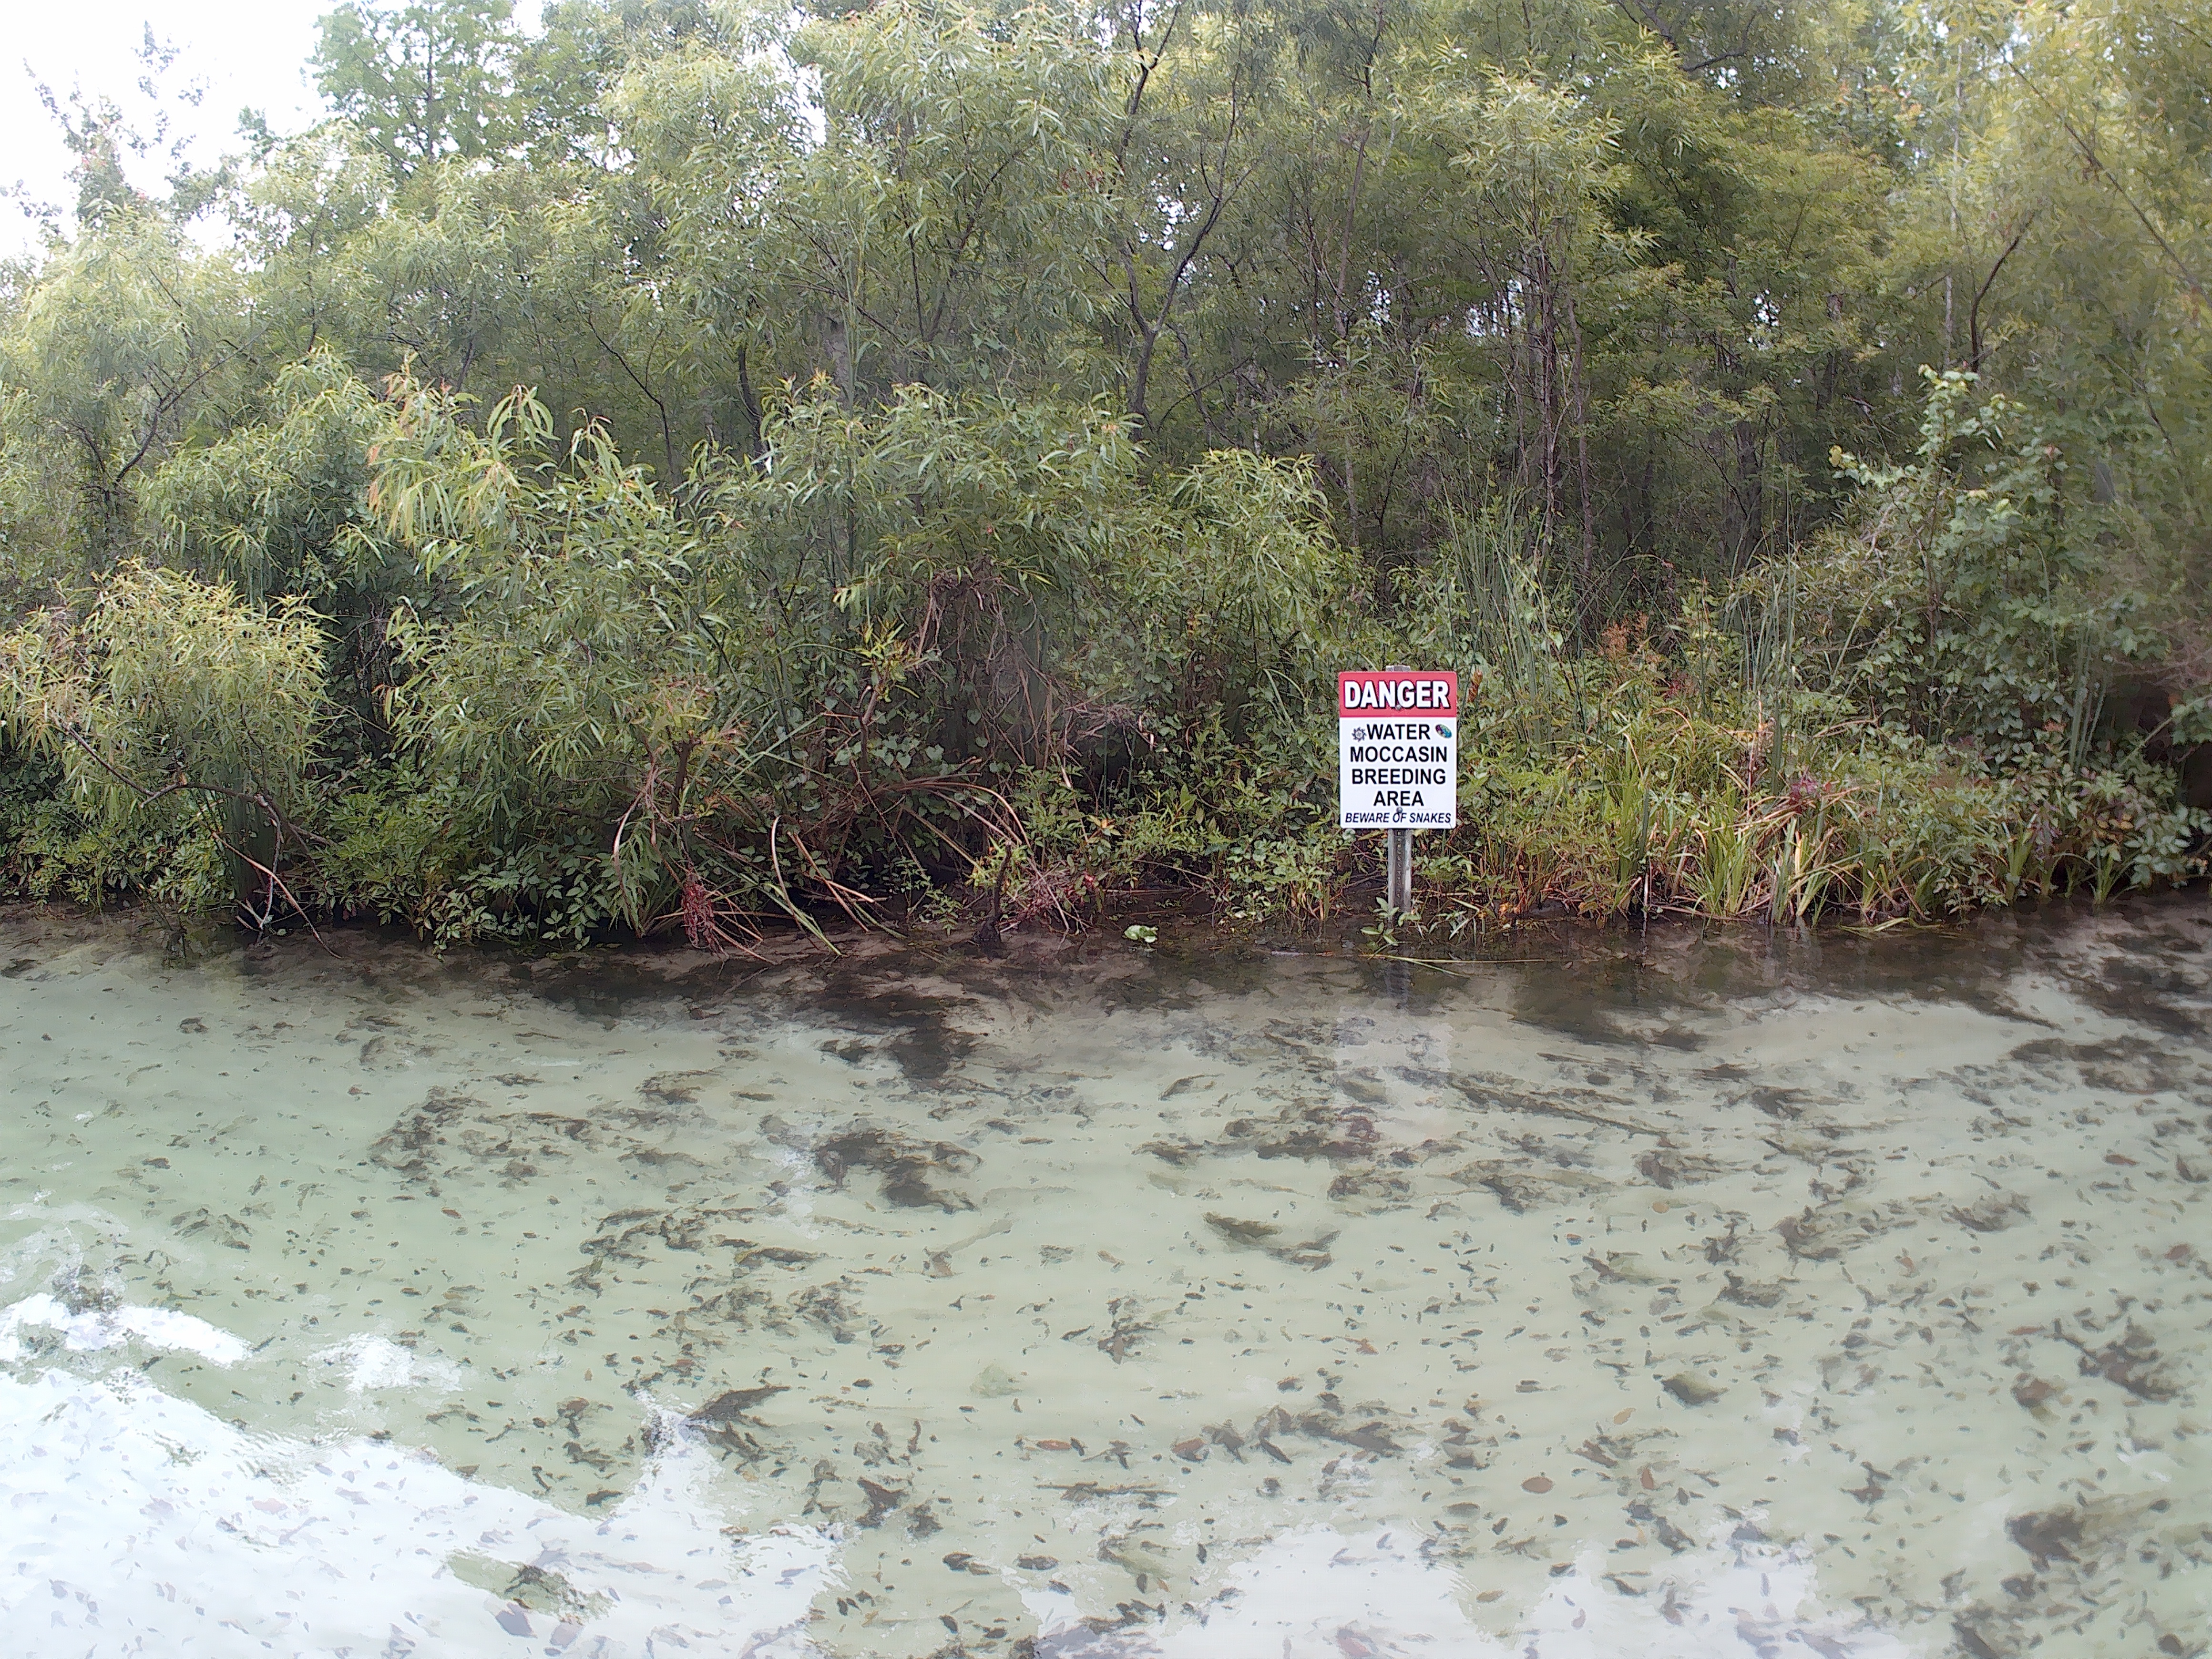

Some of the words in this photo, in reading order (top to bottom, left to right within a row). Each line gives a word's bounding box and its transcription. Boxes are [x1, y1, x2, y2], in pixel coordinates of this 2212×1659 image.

[1343, 680, 1450, 709] DANGER
[1366, 724, 1431, 740] WATER
[1350, 746, 1447, 762] MOCCASIN
[1352, 768, 1446, 785] BREEDING
[1373, 790, 1424, 806] AREA
[1345, 813, 1390, 823] BEWARE
[1393, 812, 1407, 823] OF
[1409, 813, 1452, 824] SNAKES
